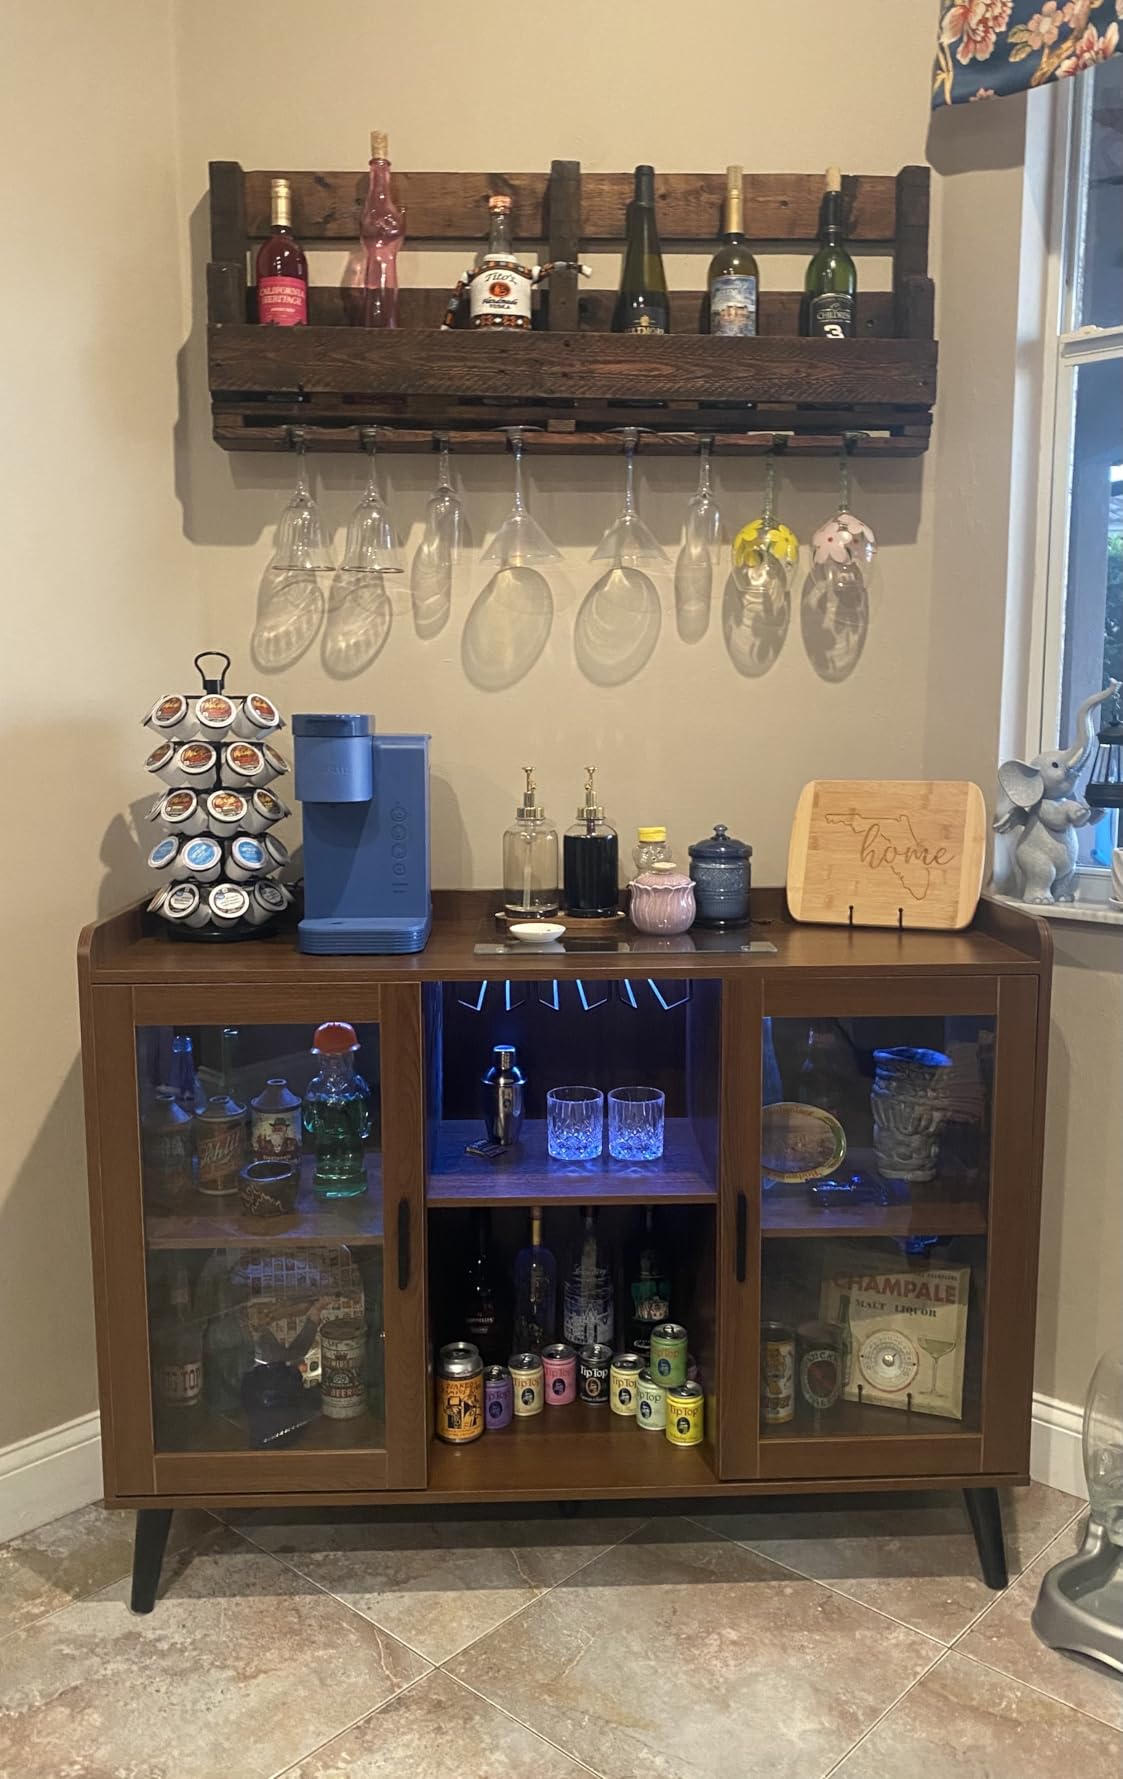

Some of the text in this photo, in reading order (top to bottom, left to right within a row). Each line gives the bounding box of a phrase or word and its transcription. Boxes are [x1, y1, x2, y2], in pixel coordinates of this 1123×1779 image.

[484, 272, 518, 285] Tito's
[823, 324, 846, 339] 3
[860, 823, 955, 869] home
[833, 1271, 956, 1305] CHAMPALE
[855, 1299, 937, 1319] MALT LIQUOR
